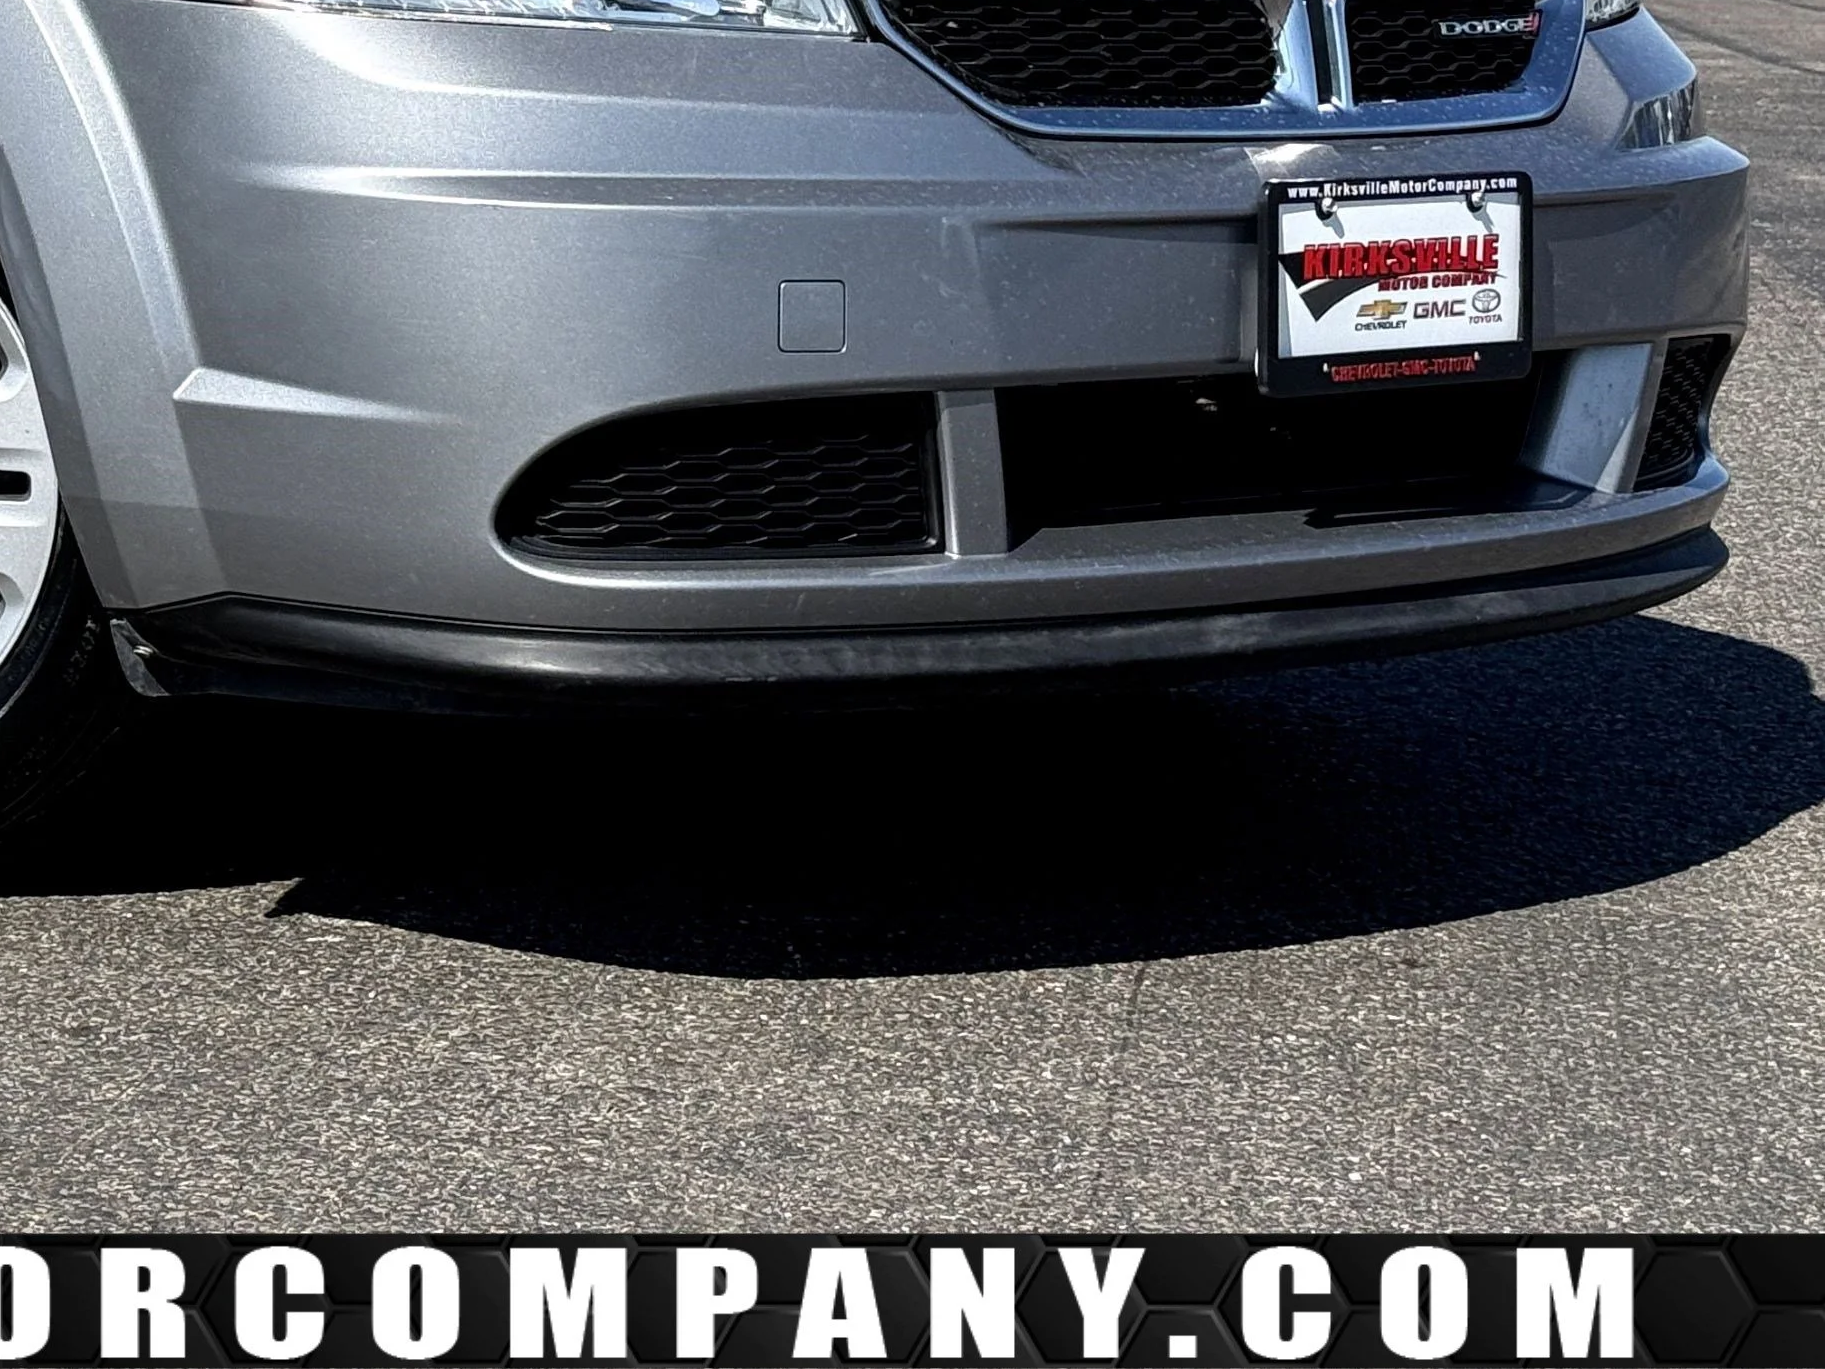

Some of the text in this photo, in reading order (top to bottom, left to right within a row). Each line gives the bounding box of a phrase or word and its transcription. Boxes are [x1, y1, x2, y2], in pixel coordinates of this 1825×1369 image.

[1438, 17, 1535, 36] DODGE
[1287, 177, 1517, 198] www.KirksvilleMotorCompany.com
[1302, 233, 1499, 281] KIRKSVILLE
[1378, 272, 1496, 292] MOTOR COMPANY
[1413, 299, 1466, 319] GMC
[1469, 314, 1502, 324] TOYOTA
[1354, 320, 1407, 332] CHEVROLET
